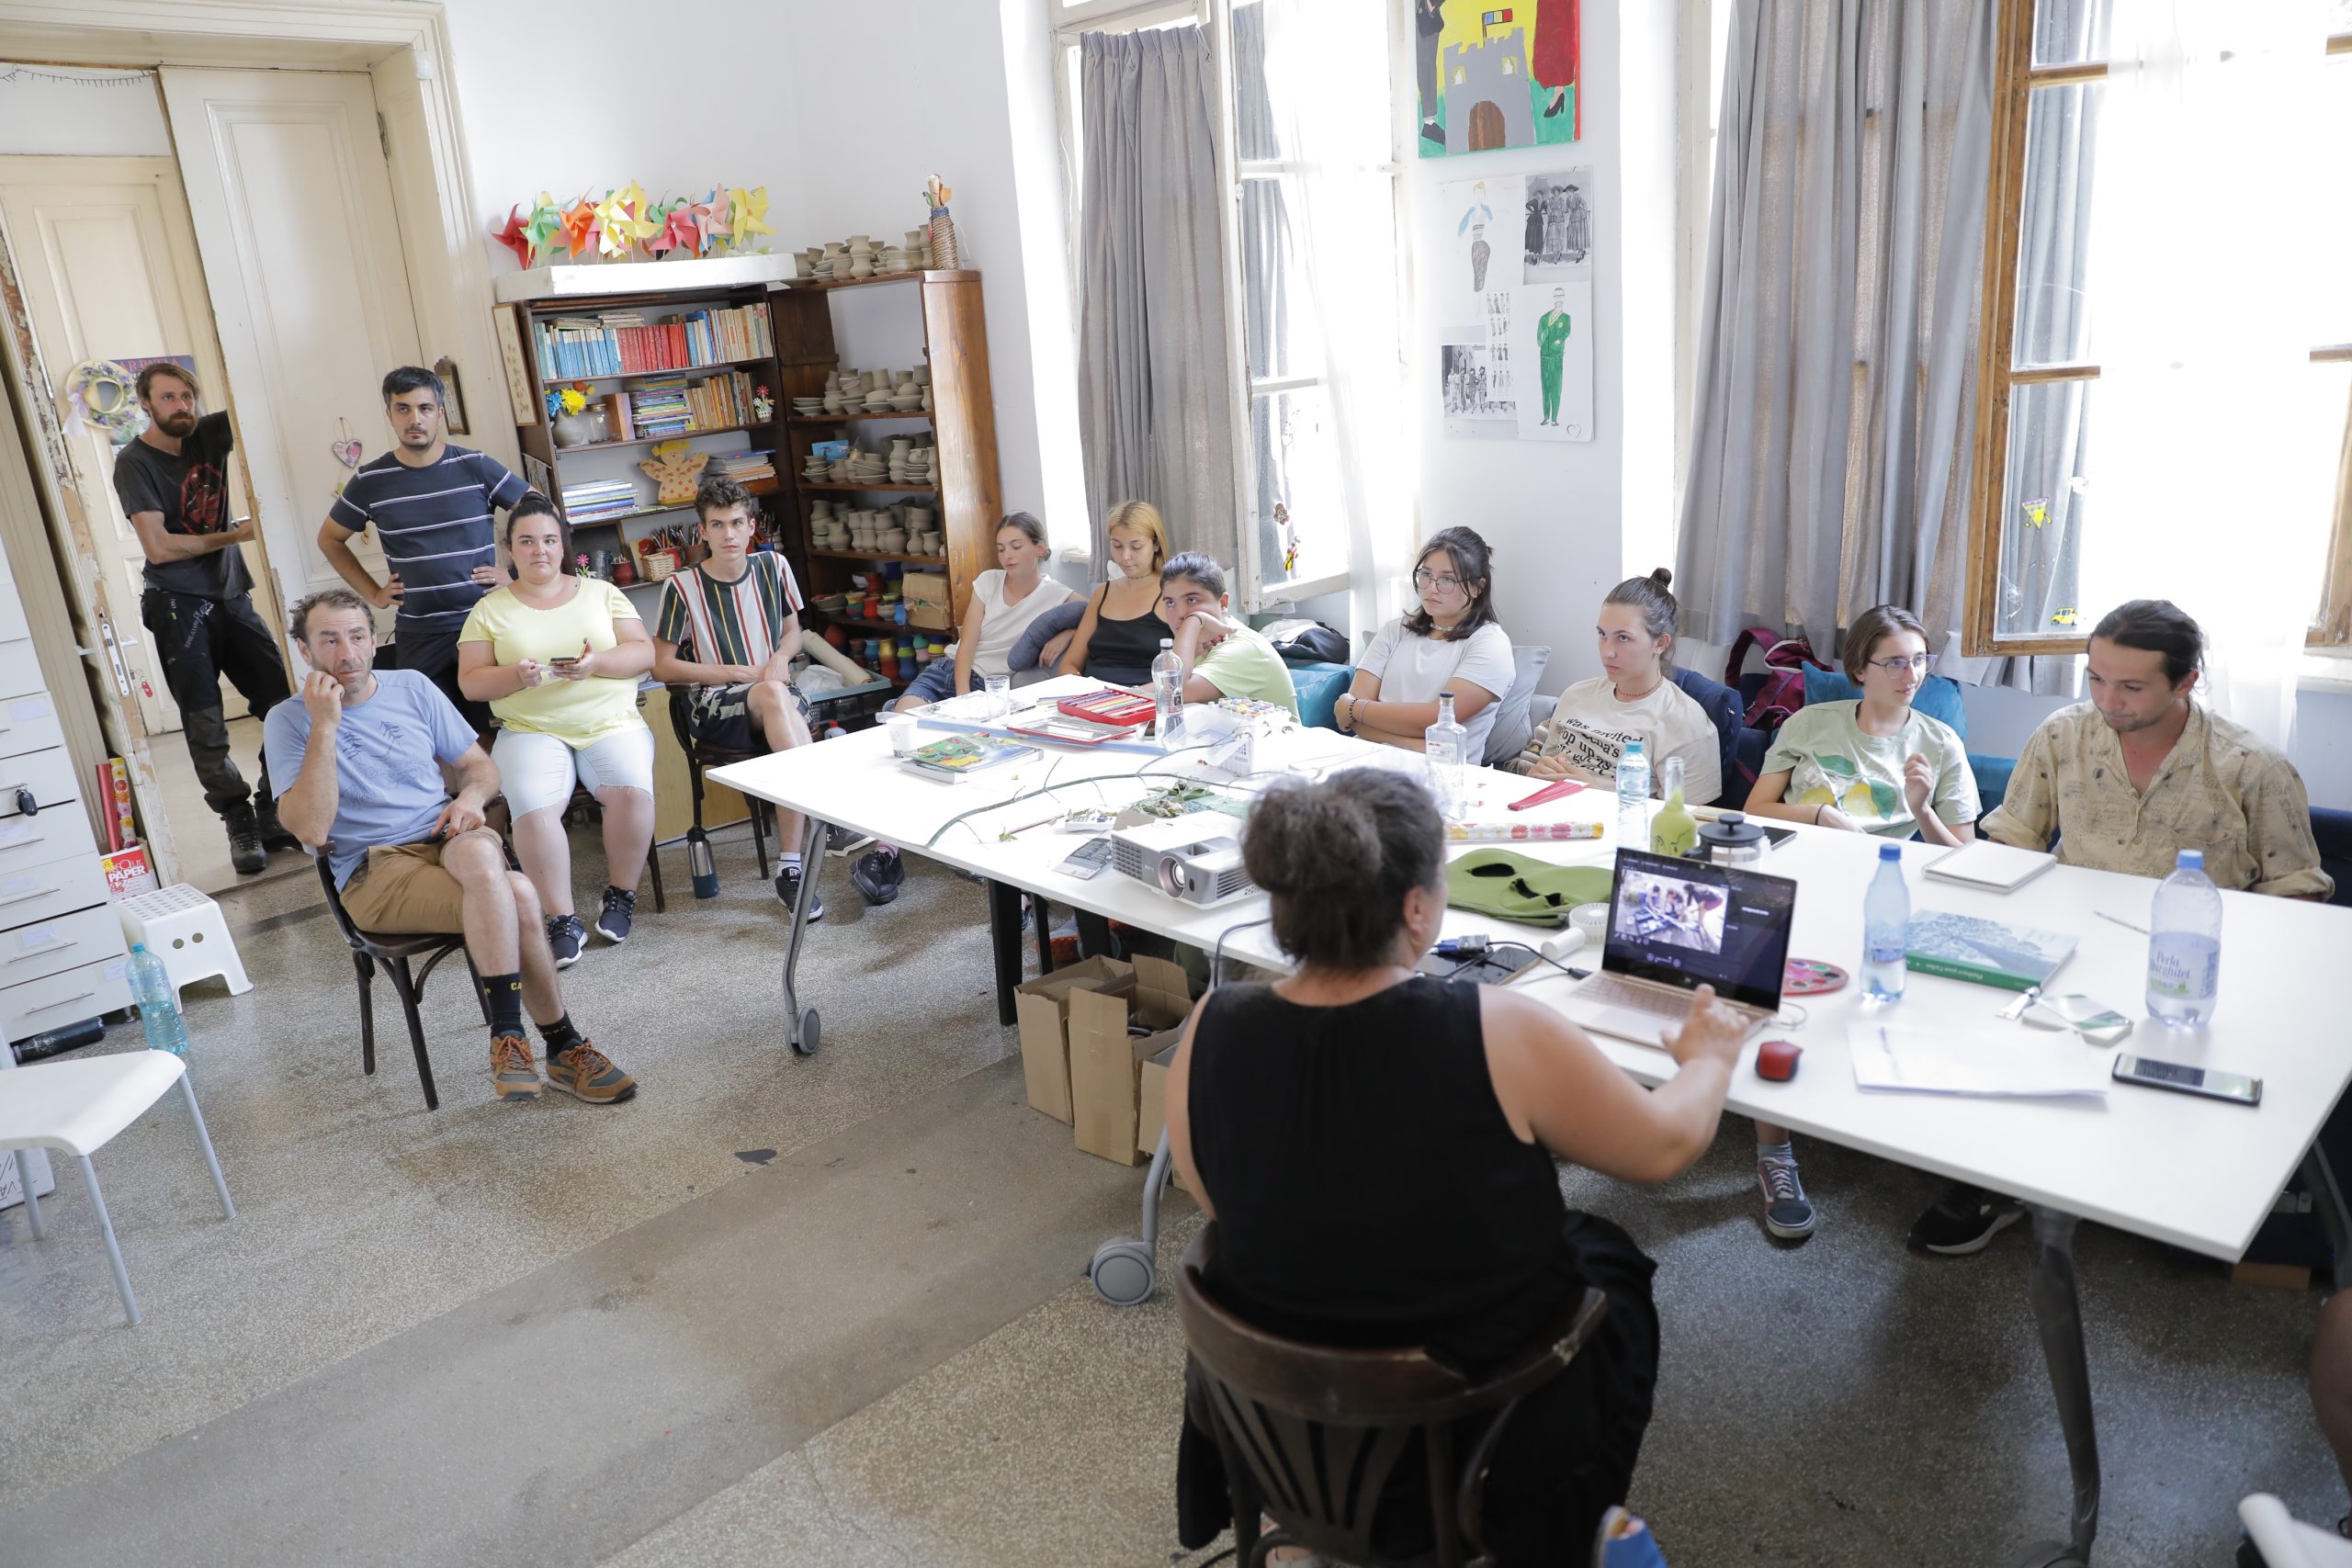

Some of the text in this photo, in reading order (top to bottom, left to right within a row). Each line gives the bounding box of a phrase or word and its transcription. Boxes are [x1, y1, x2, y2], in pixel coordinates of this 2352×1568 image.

[1566, 718, 1589, 729] was
[107, 865, 146, 883] PAPER
[2156, 950, 2180, 968] Perla
